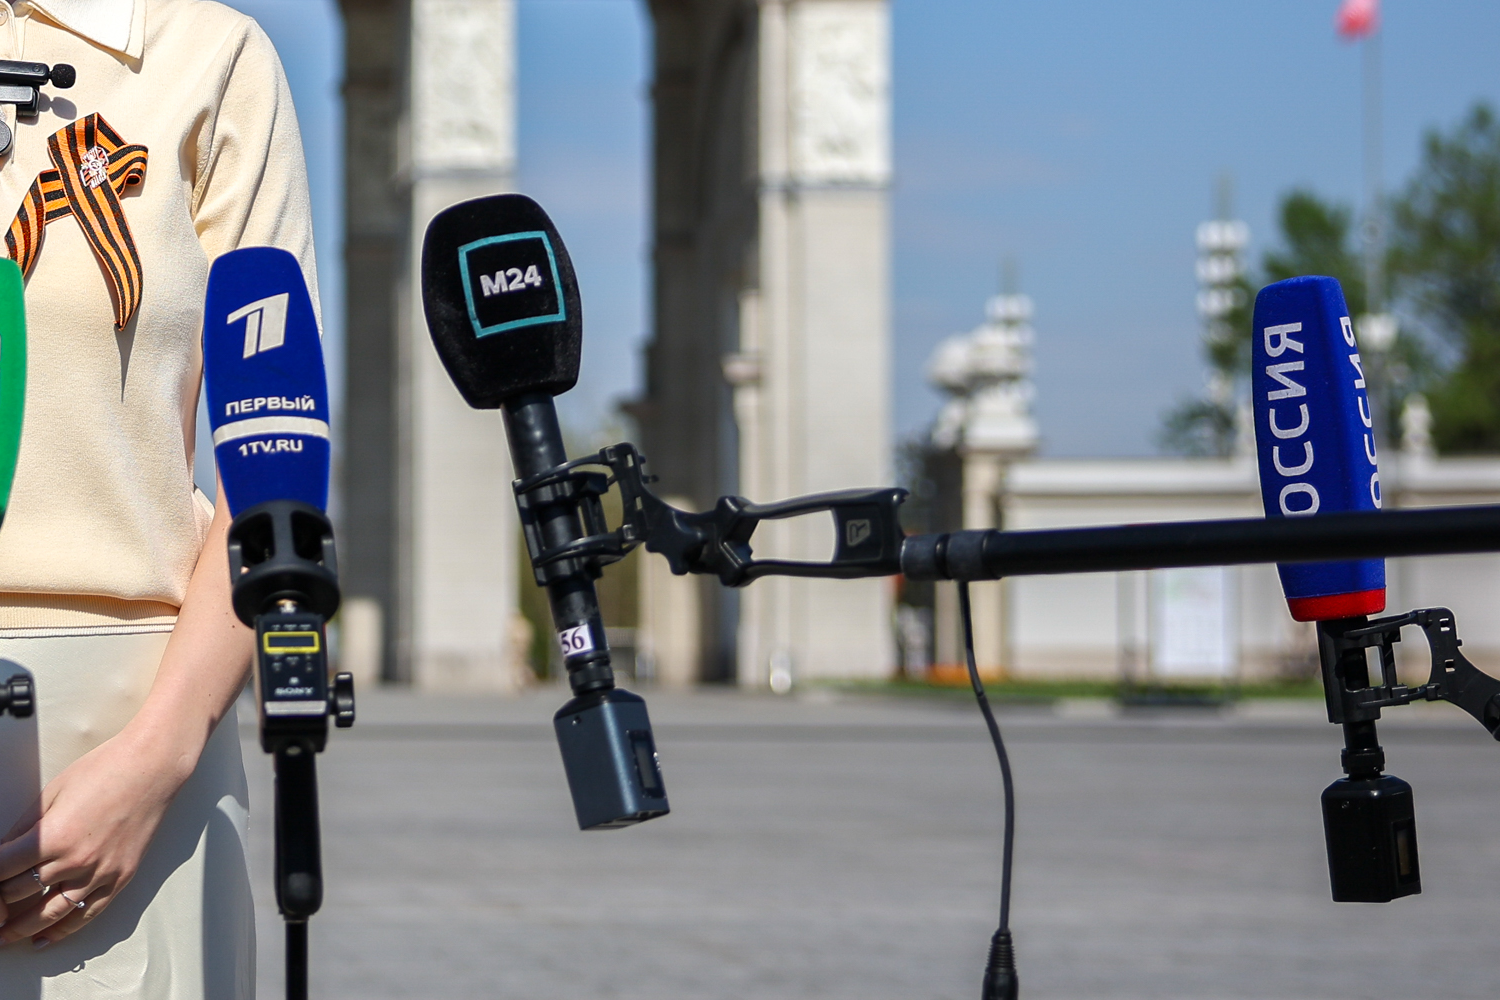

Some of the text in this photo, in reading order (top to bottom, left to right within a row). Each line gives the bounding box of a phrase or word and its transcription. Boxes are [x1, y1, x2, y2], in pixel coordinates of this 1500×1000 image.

[225, 394, 316, 417] ПЕРВЫЙ
[1263, 321, 1320, 517] ОССИЯ
[1339, 316, 1382, 510] ОССИЯ
[238, 439, 304, 457] 1TV.RU
[560, 626, 585, 655] 56
